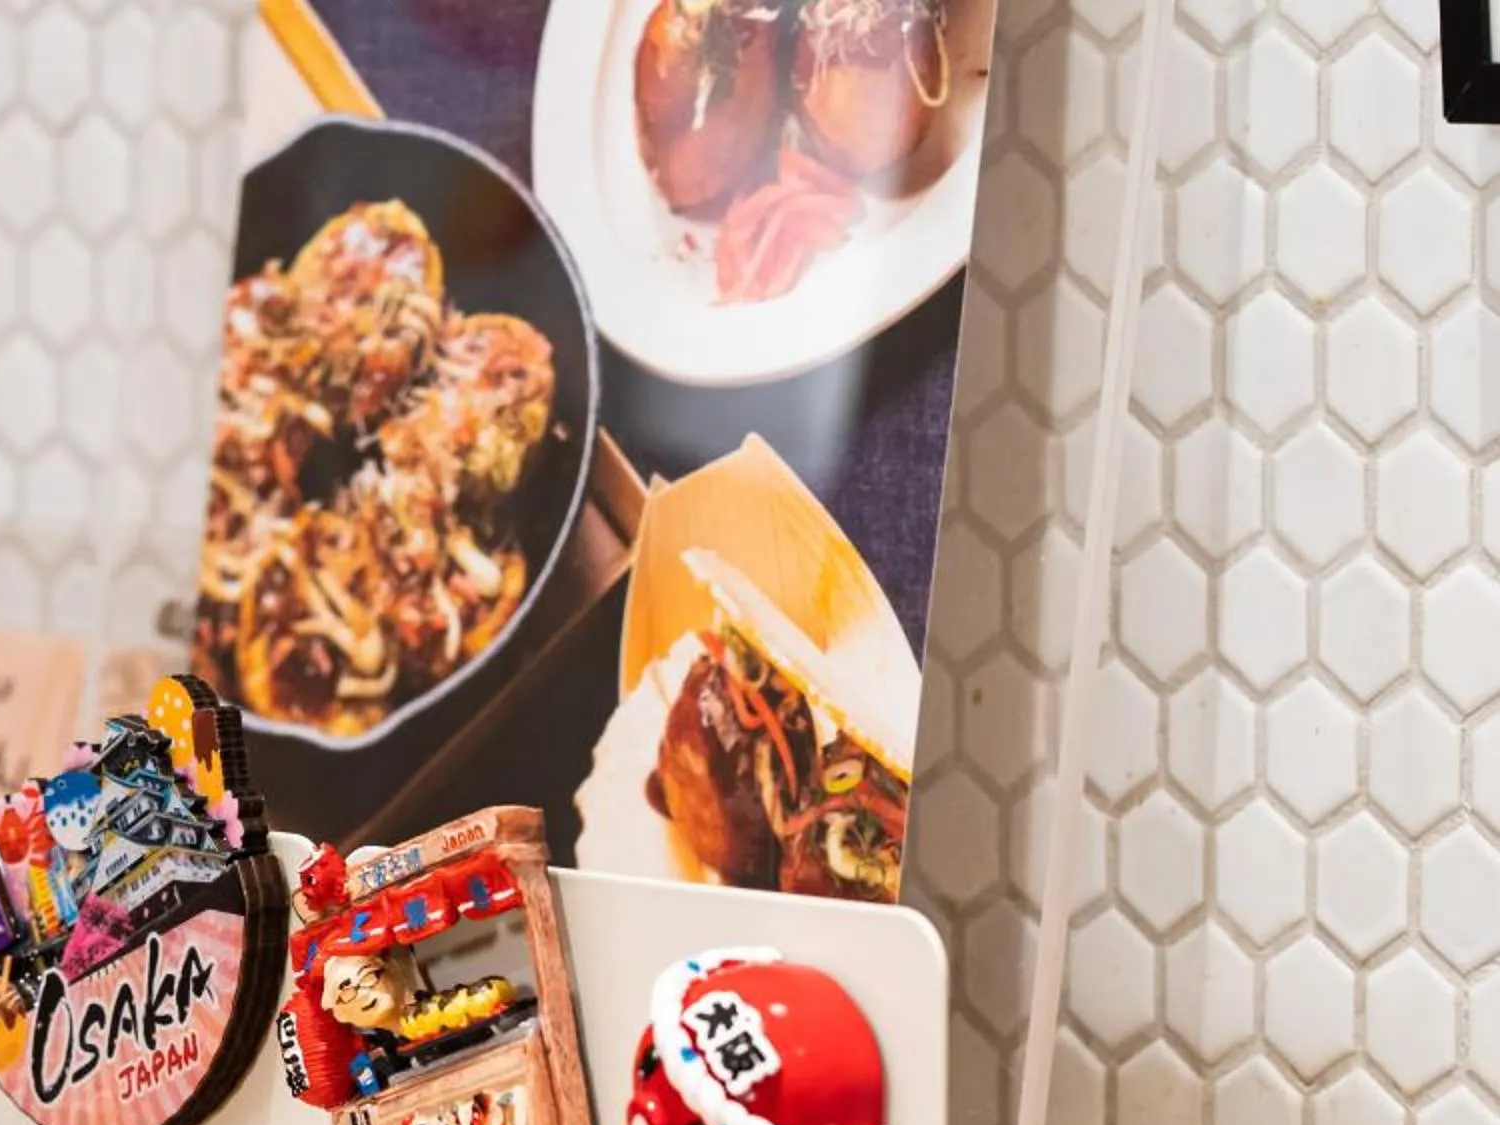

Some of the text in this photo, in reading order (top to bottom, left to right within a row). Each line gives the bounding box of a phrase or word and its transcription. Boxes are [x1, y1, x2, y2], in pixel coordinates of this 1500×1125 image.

[441, 823, 486, 853] Japan
[118, 1032, 198, 1099] JAPAN
[696, 1001, 767, 1081] 大阪
